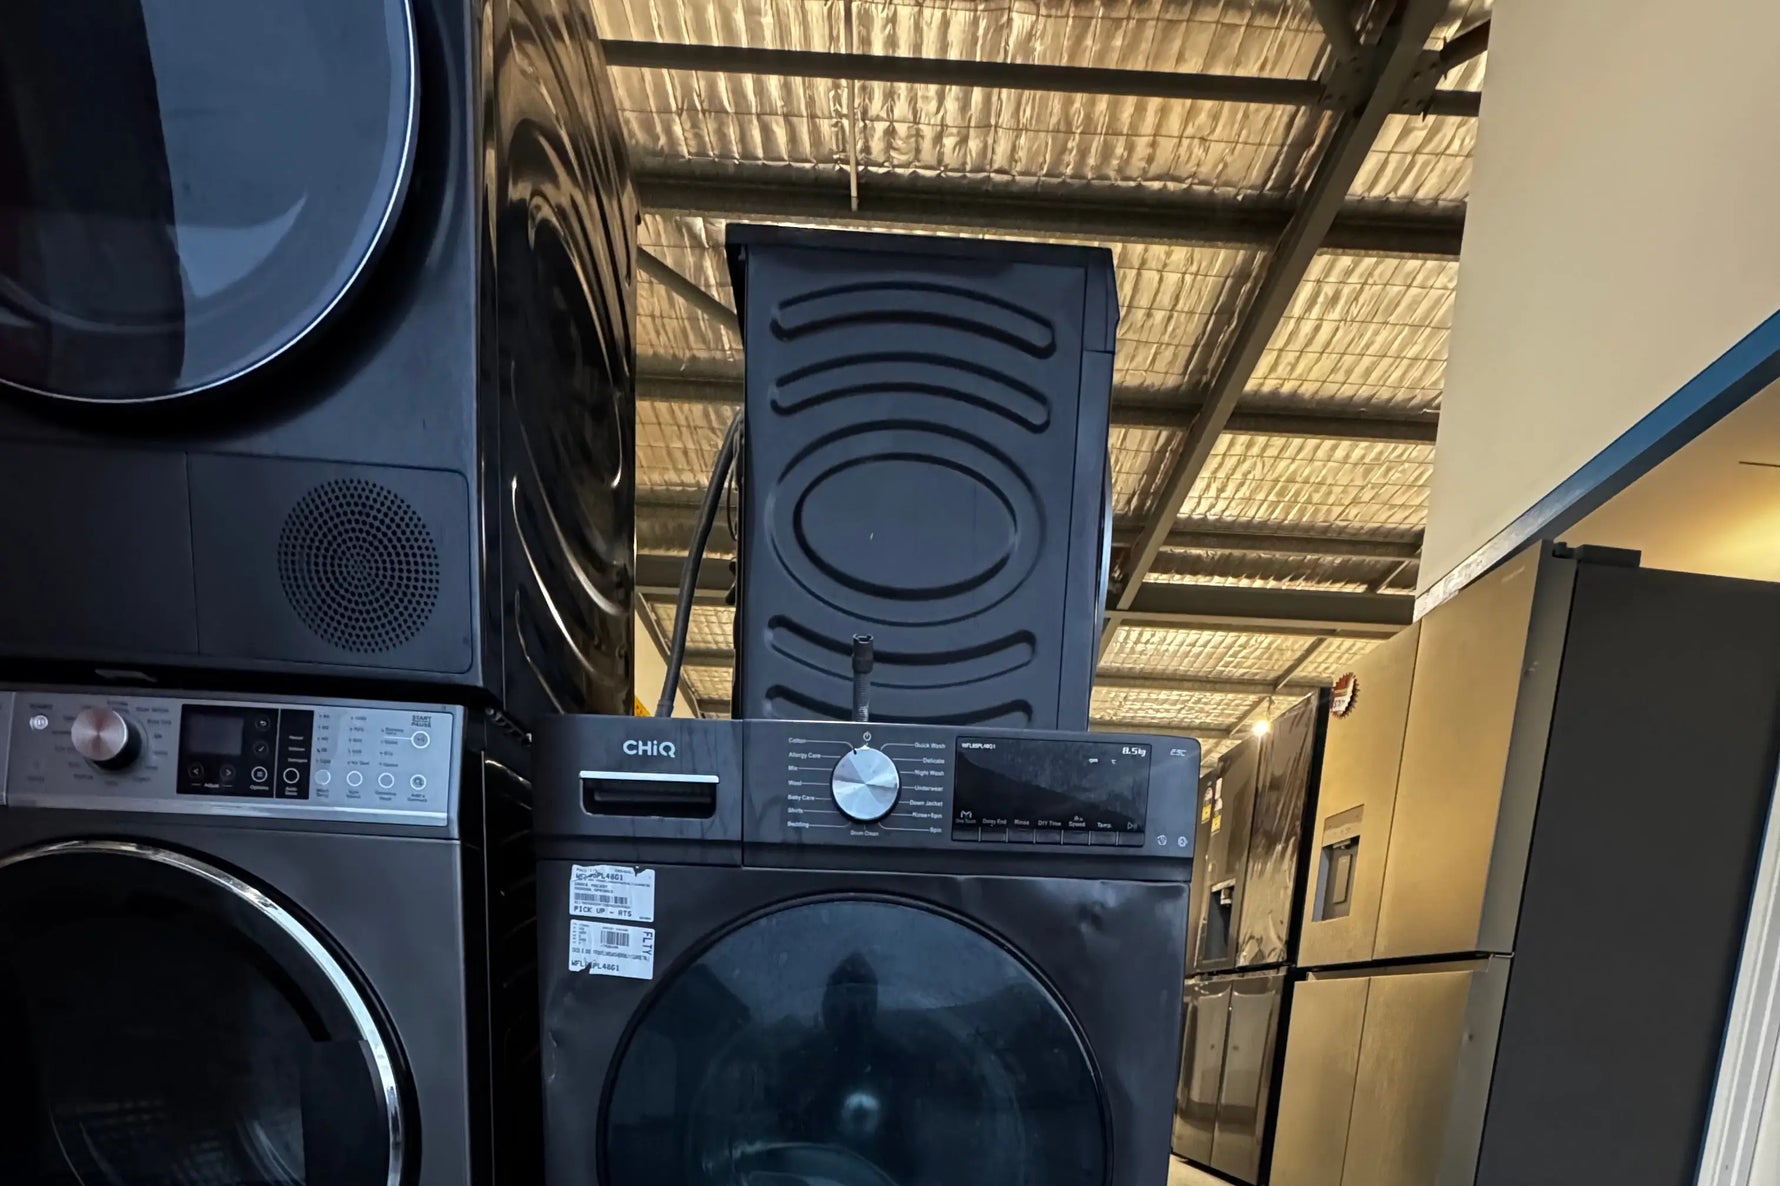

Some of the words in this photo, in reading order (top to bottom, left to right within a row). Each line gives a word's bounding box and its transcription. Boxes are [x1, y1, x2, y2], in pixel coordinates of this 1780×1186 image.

[623, 740, 676, 758] CHiQ
[1122, 747, 1146, 757] 8.5kg
[642, 931, 653, 956] FLTY
